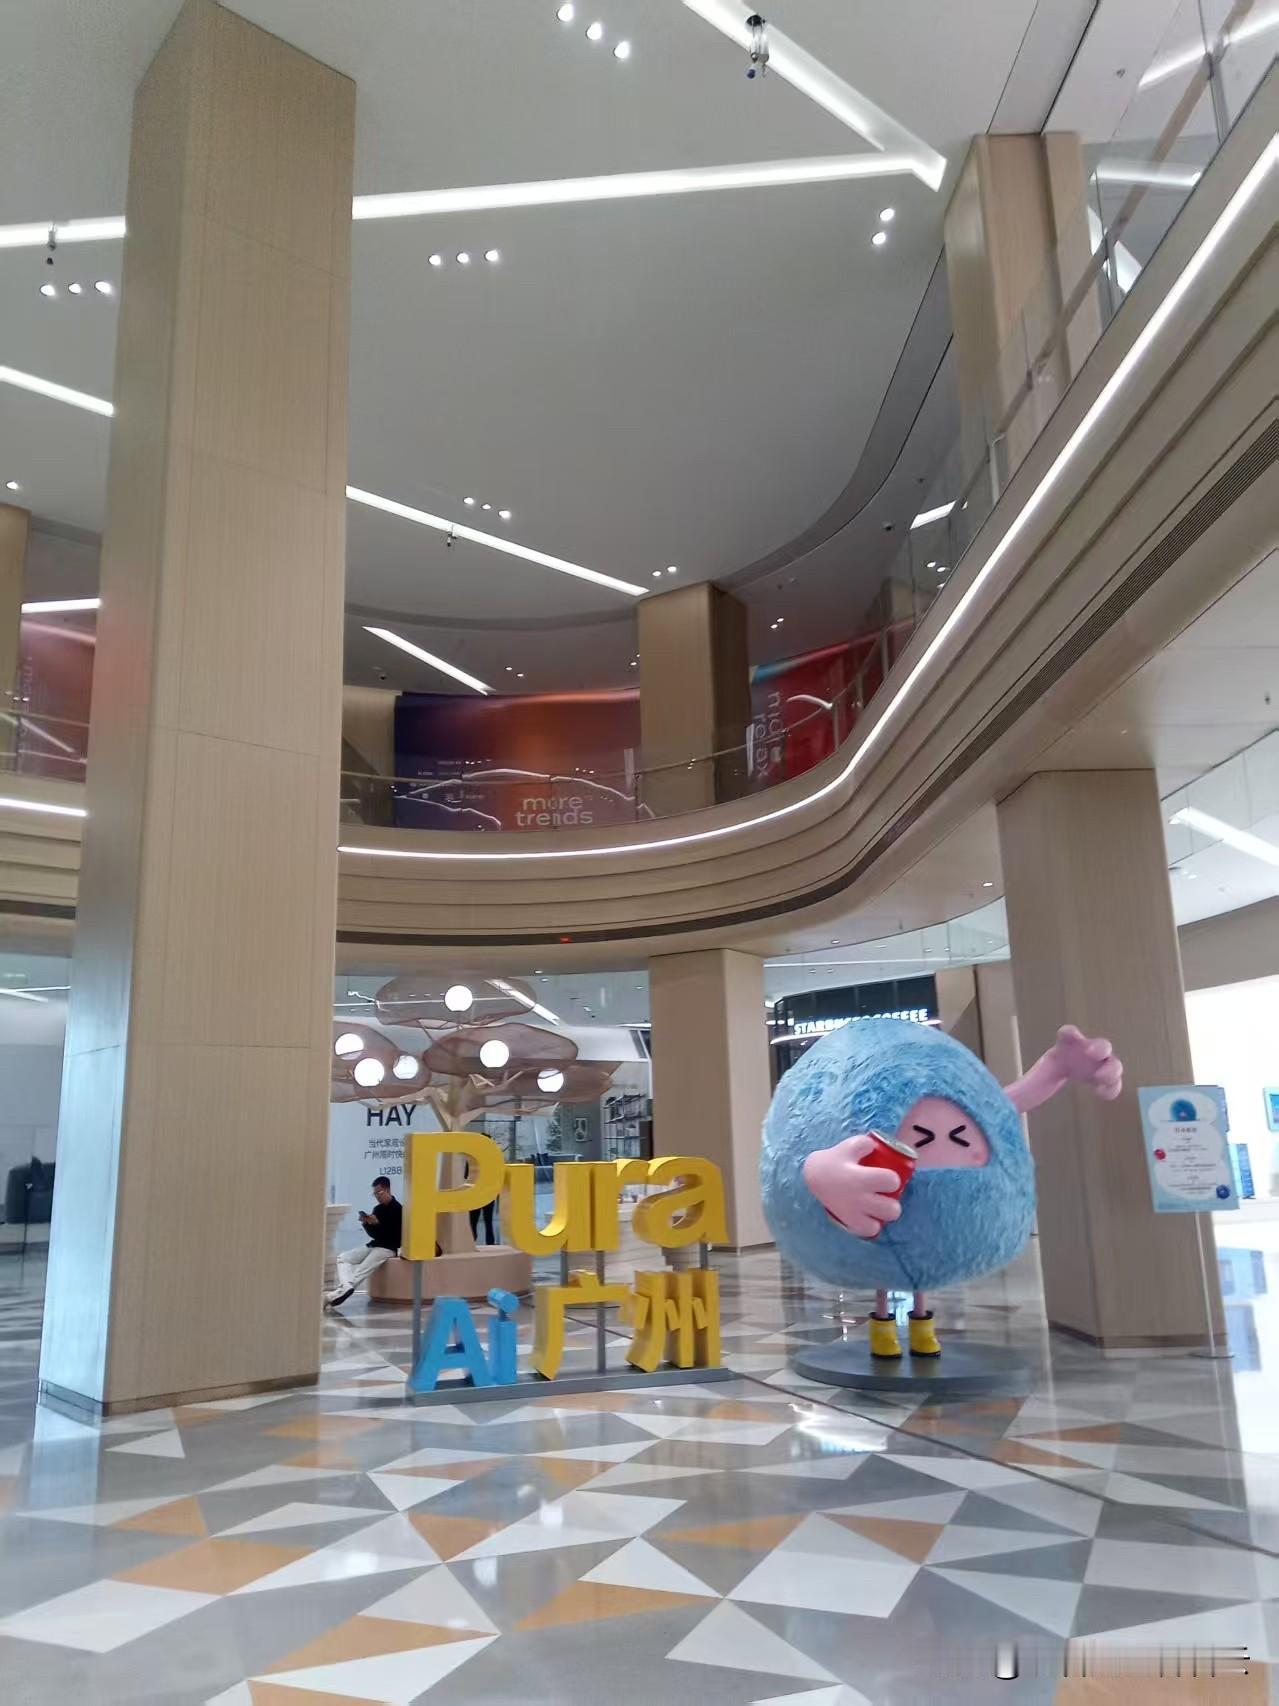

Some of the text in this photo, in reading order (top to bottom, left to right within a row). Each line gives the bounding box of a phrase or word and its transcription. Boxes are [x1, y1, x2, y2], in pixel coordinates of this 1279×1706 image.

[754, 713, 769, 777] reax
[794, 1016, 871, 1035] STARBU
[367, 1104, 416, 1126] HAY
[406, 1132, 729, 1260] Pura
[414, 1270, 720, 1391] Ai 广州
